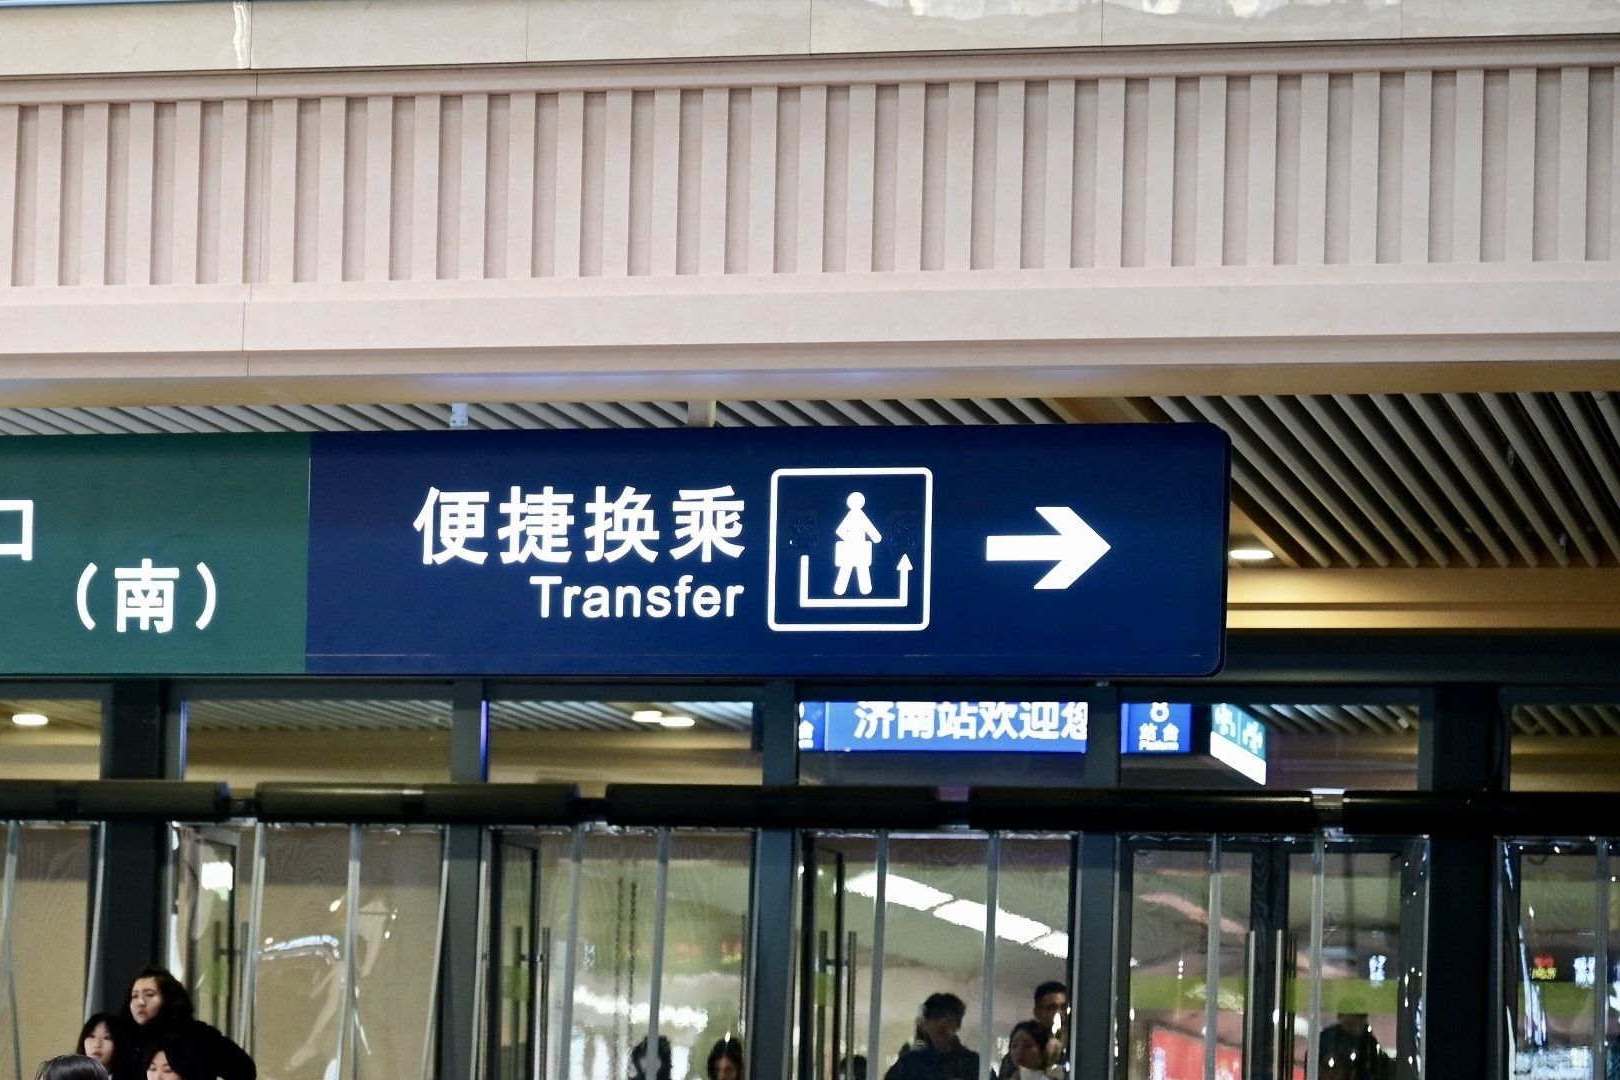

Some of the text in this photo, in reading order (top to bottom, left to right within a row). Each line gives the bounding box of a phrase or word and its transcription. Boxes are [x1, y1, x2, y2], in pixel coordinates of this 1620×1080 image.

[412, 485, 746, 565] 便捷换乘
[530, 574, 745, 619] Transfer
